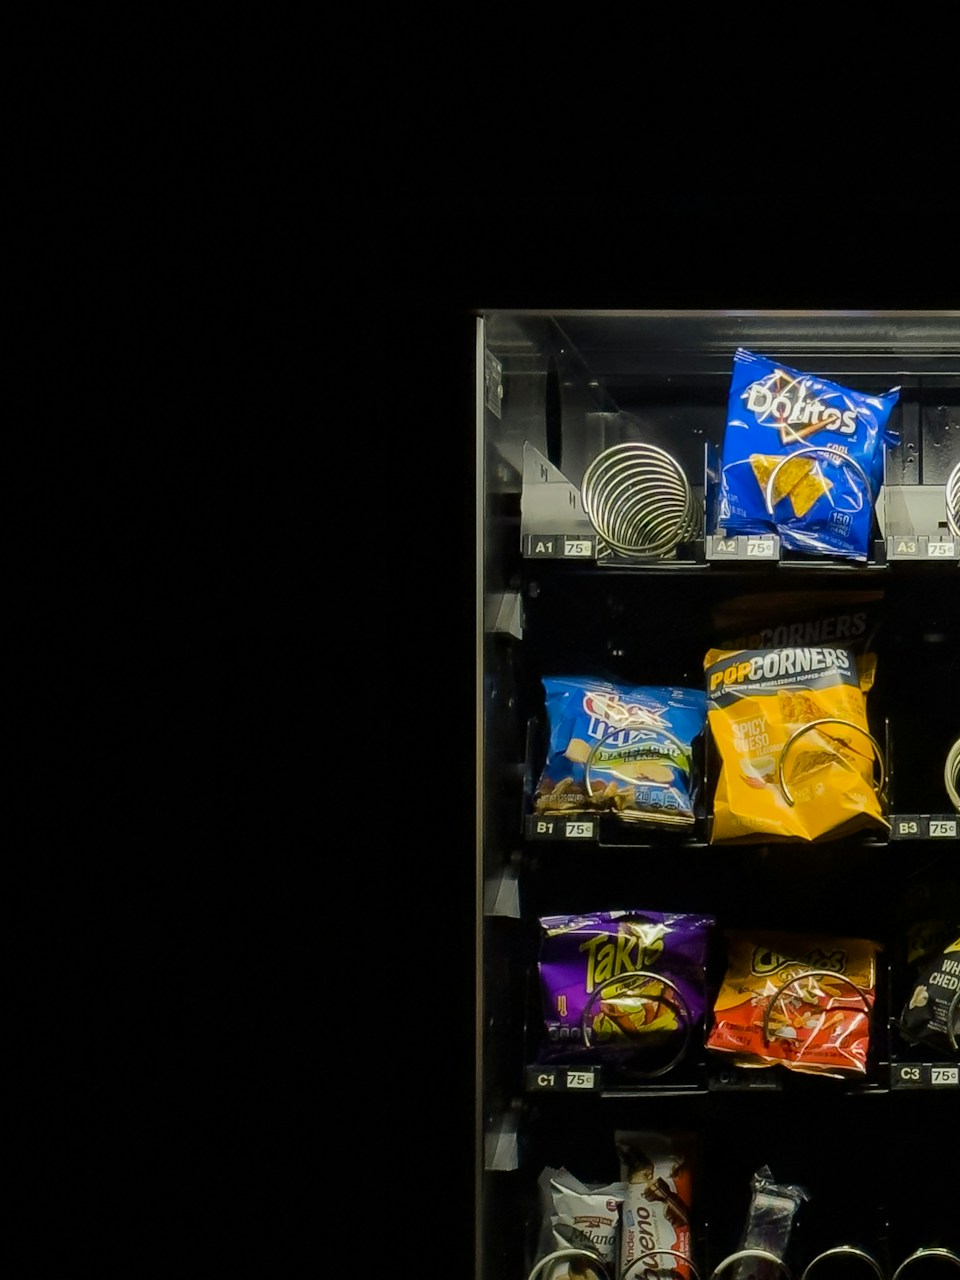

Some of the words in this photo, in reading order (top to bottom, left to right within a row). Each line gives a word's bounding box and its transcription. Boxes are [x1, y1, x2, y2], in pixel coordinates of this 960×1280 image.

[747, 384, 857, 434] Doritos
[832, 511, 850, 525] 150
[535, 541, 553, 553] A1
[717, 540, 736, 552] A2
[898, 542, 916, 553] A3
[709, 648, 850, 691] POPCORNERS
[731, 717, 767, 737] SPICY
[536, 821, 554, 834] B1
[899, 822, 918, 834] B3
[537, 1074, 555, 1086] C1
[900, 1067, 920, 1080] C3
